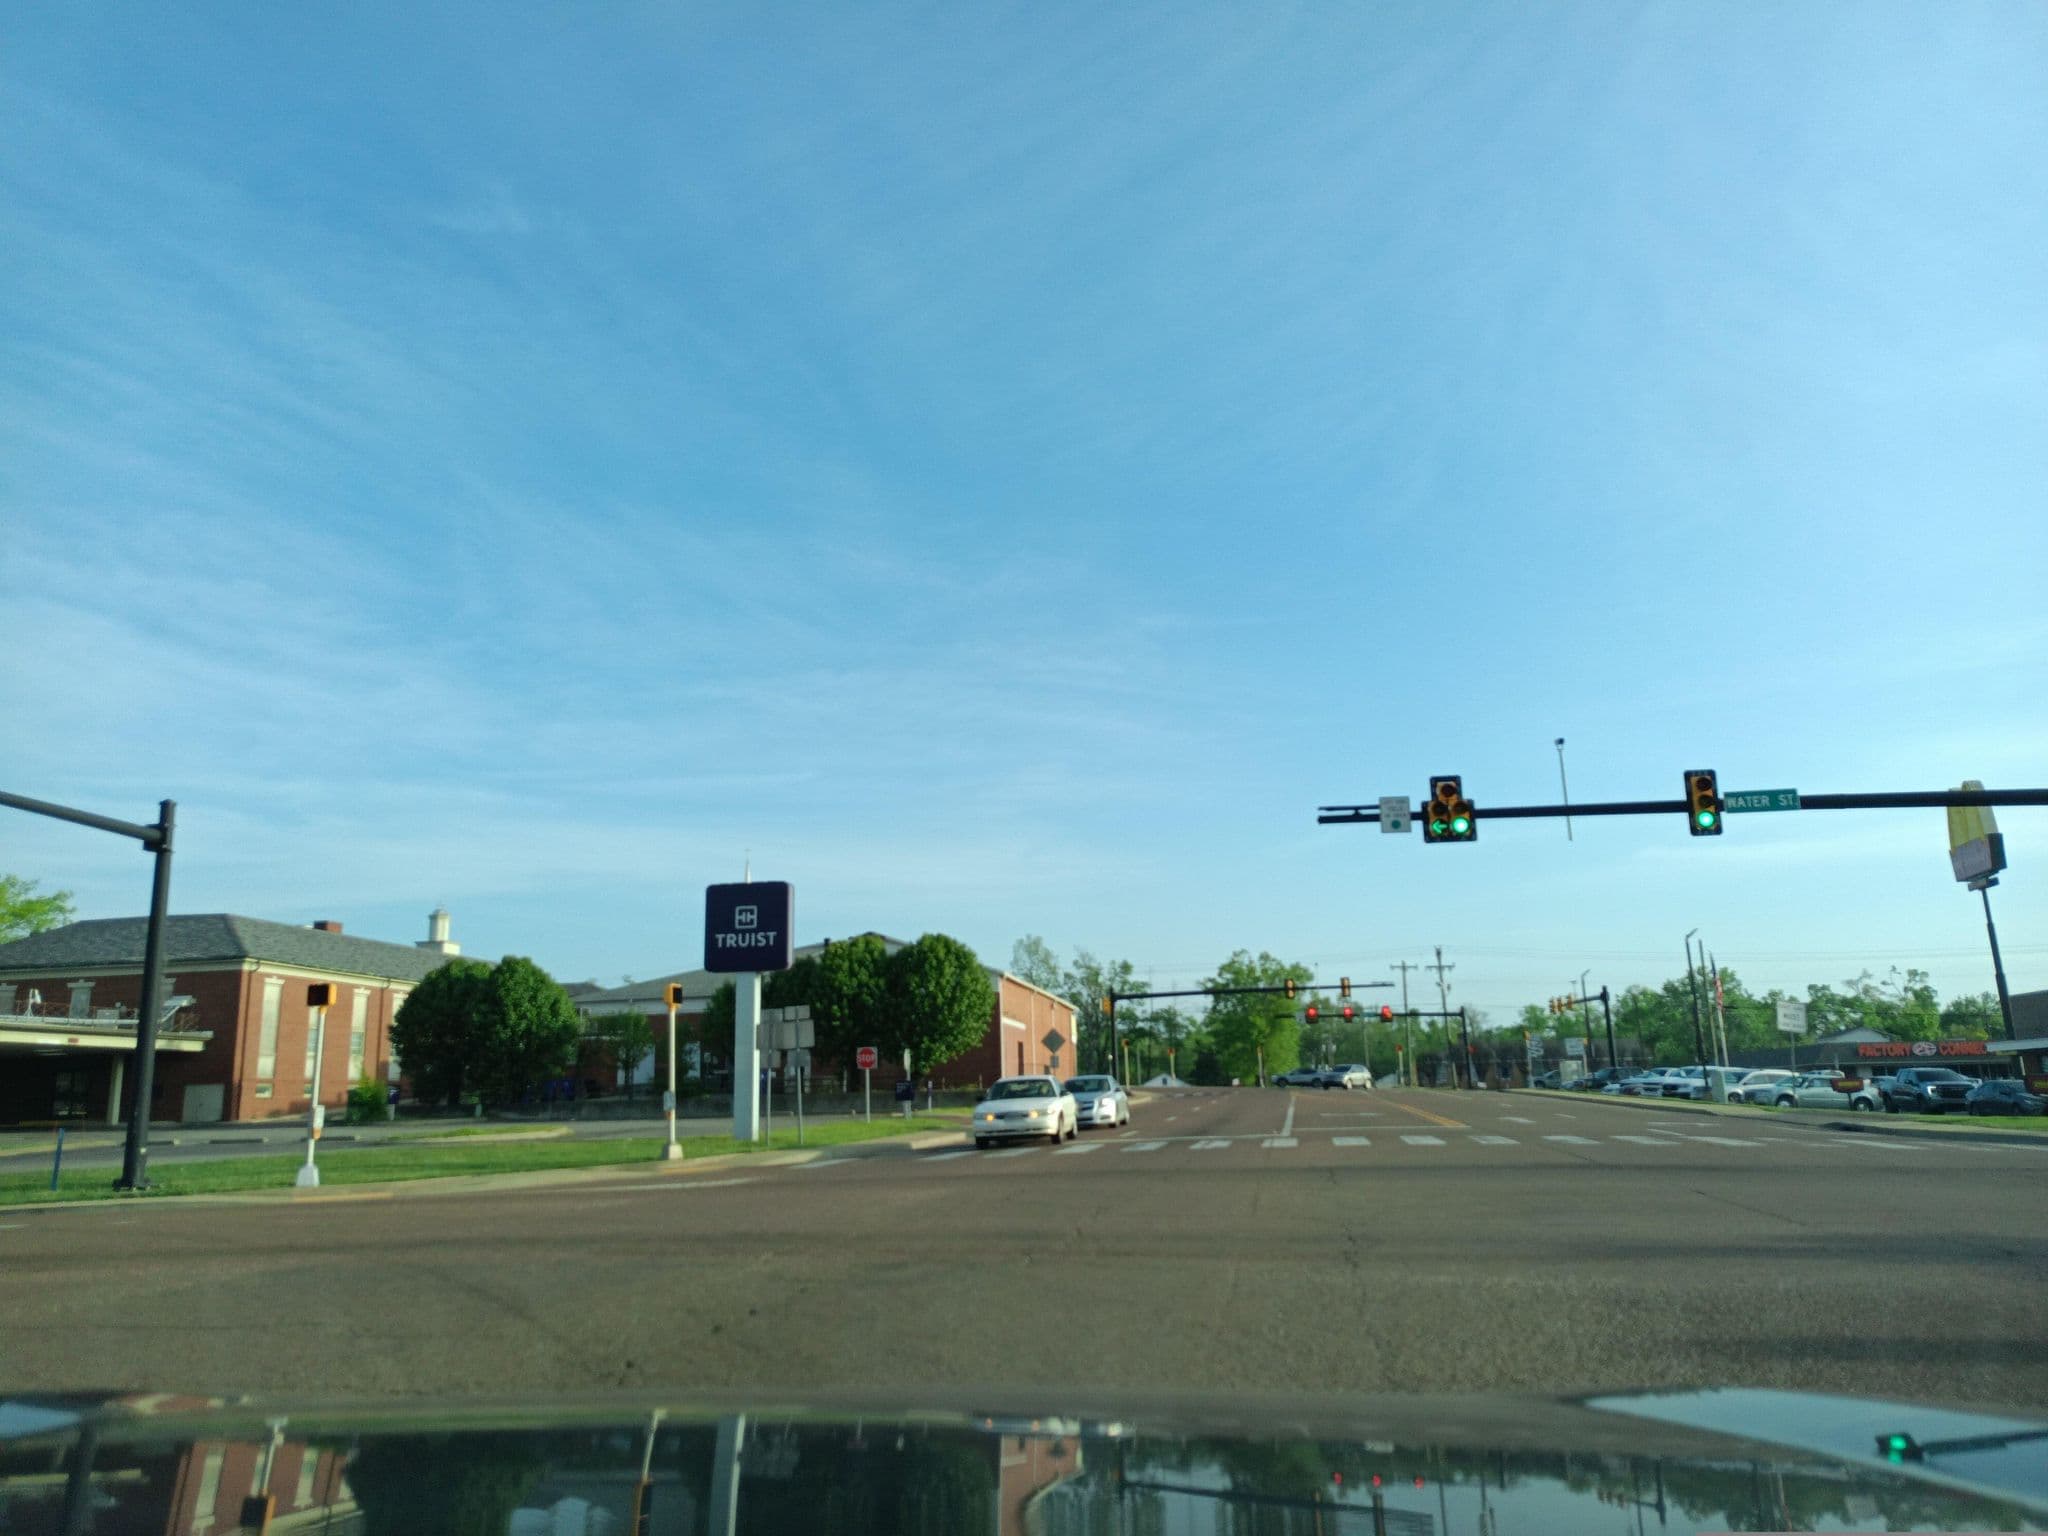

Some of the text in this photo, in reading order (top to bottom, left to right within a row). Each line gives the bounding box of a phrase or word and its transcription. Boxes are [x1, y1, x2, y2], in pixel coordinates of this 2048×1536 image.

[1727, 793, 1793, 809] WATER ST
[715, 931, 777, 948] TRUIST
[1858, 1043, 1912, 1057] FACTORY
[856, 1053, 876, 1064] STOP
